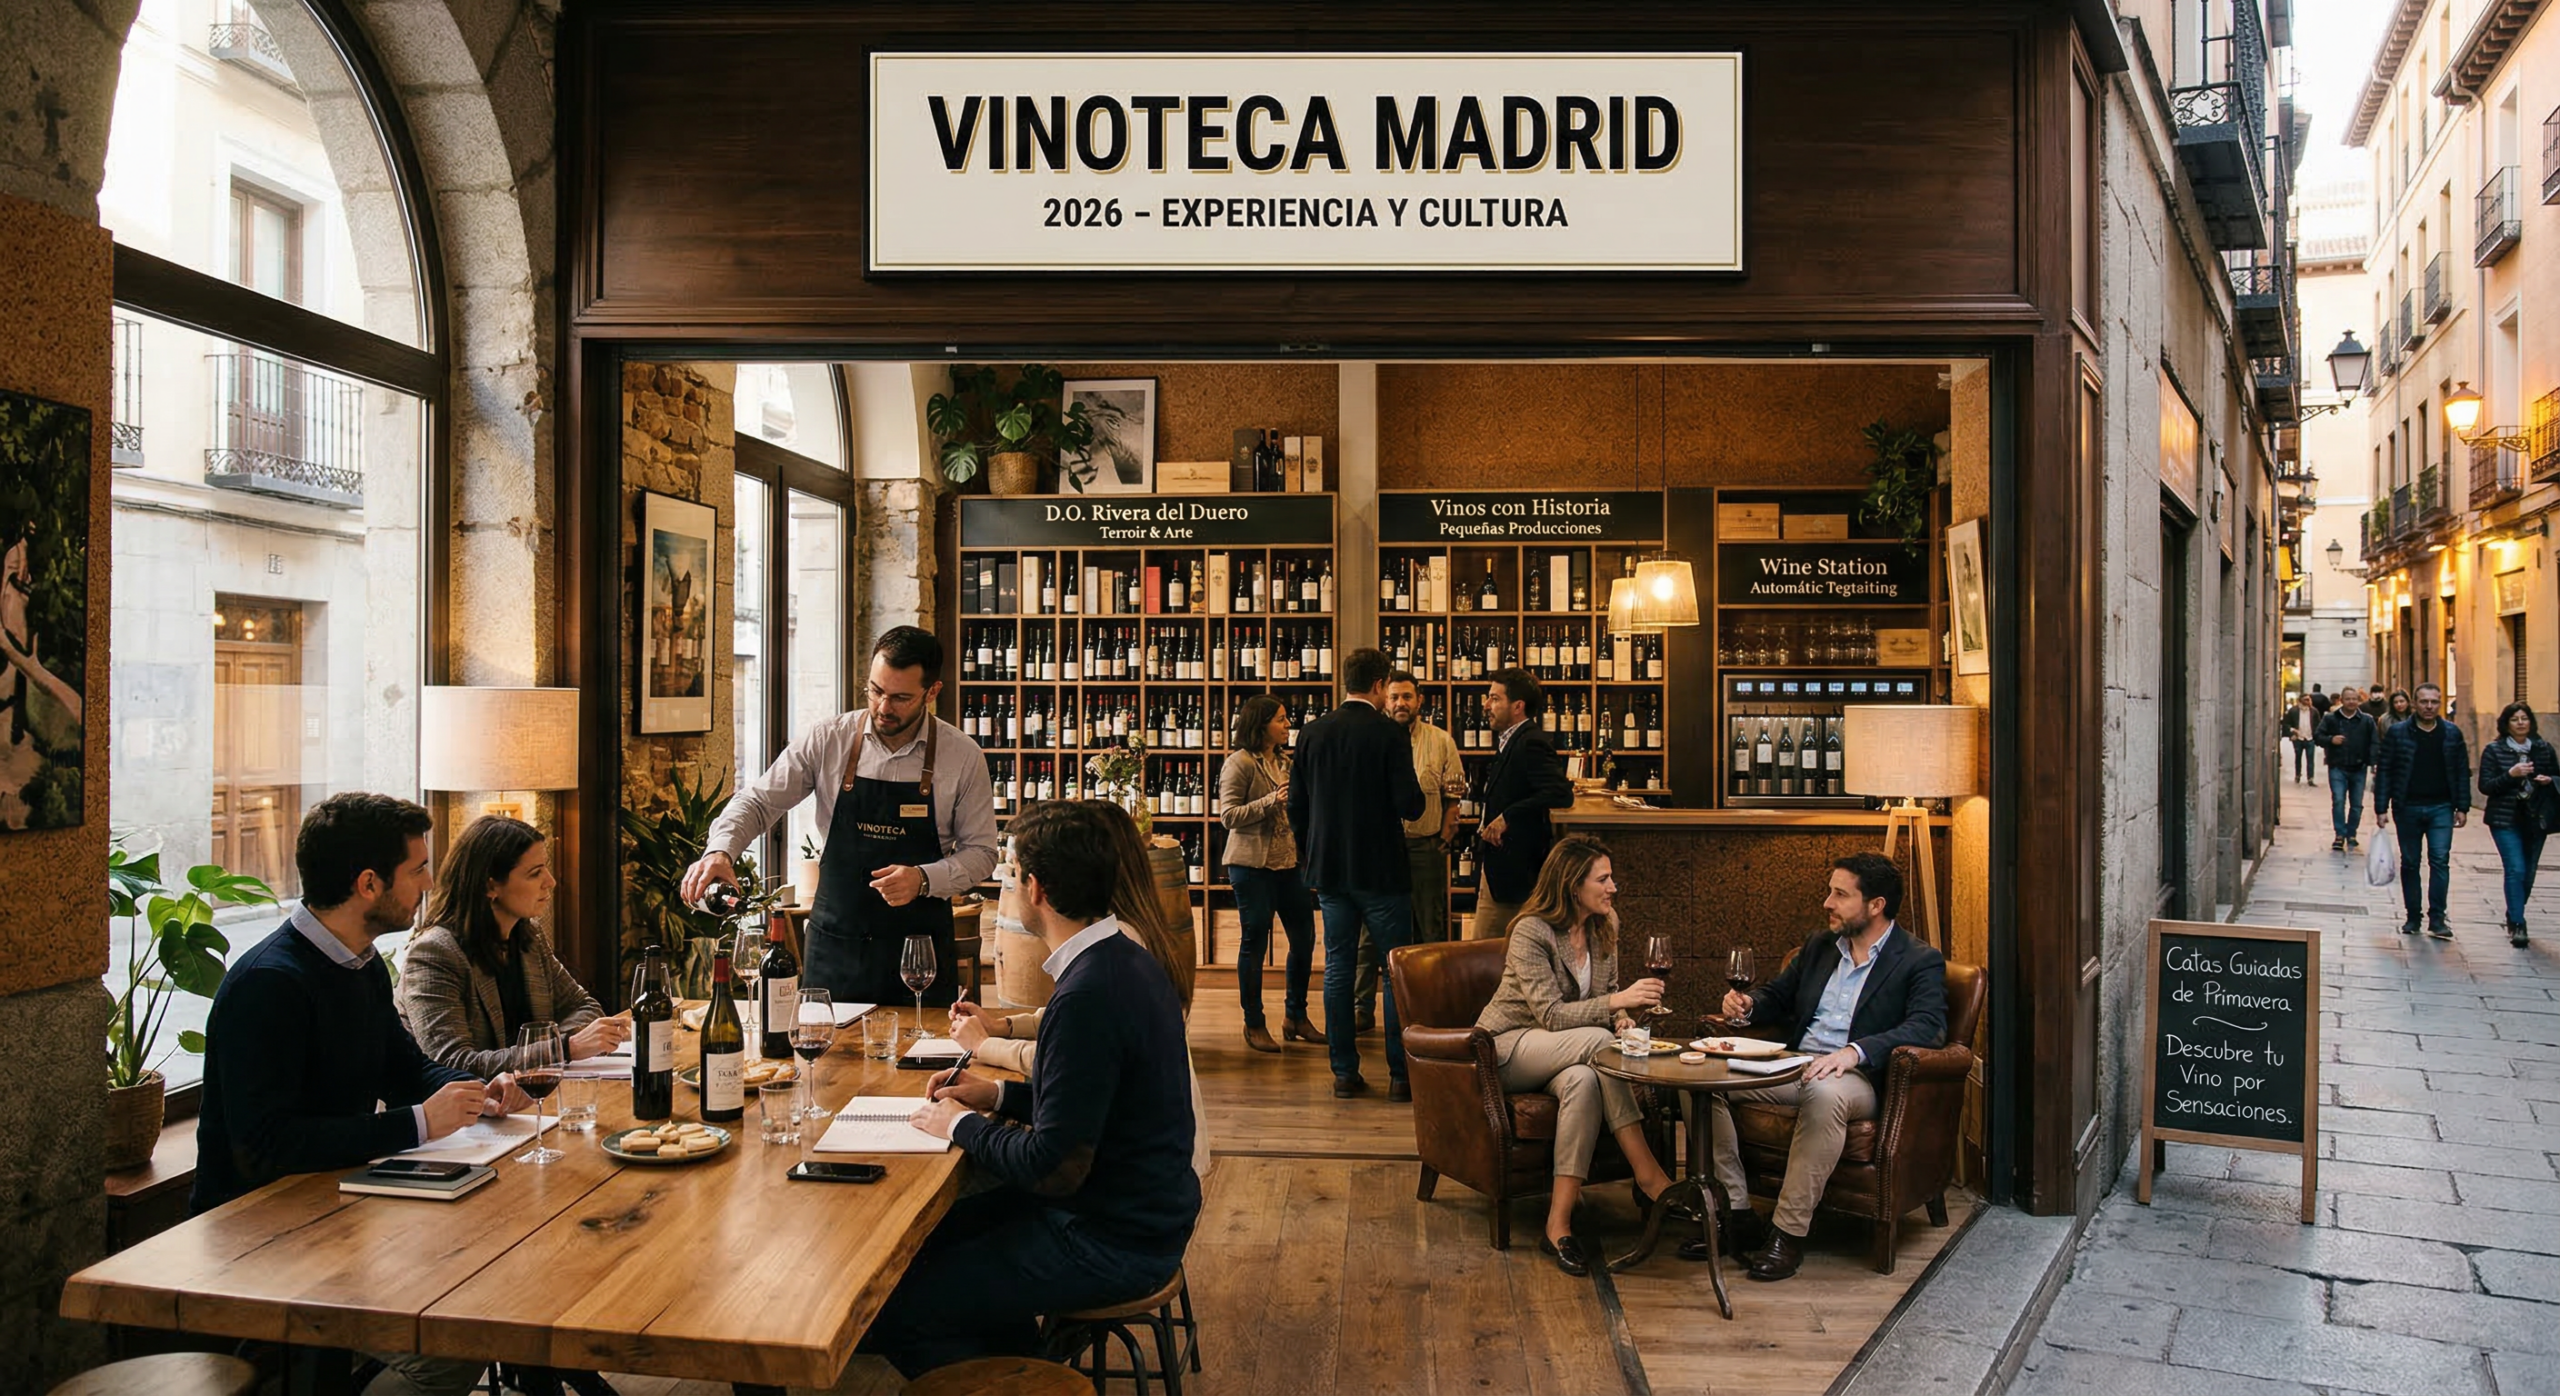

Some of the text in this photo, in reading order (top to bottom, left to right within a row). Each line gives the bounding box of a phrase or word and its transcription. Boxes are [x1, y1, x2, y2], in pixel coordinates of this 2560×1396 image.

[928, 95, 1681, 173] VINOTECA MADRID
[1043, 198, 1123, 228] 2026
[1162, 198, 1379, 228] EXPERIENCIA
[1388, 198, 1409, 227] Y
[1419, 198, 1569, 228] CULTURA
[1045, 503, 1249, 521] D.O. Rivera del Duero
[1431, 498, 1611, 516] Vinos con Historia
[1099, 526, 1193, 539] Terroir & Arte
[1440, 521, 1602, 538] Pequeñas Producciones
[1760, 557, 1888, 575] Wine Station
[1750, 580, 1824, 594] Automátic
[857, 822, 906, 835] VINOTECA
[2166, 946, 2303, 980] Catas Guiadas
[2172, 981, 2293, 1012] de Primavera
[2165, 1033, 2285, 1067] Descubre tu
[2179, 1063, 2266, 1097] Vino por
[2165, 1090, 2293, 1124] Sensaciones.
